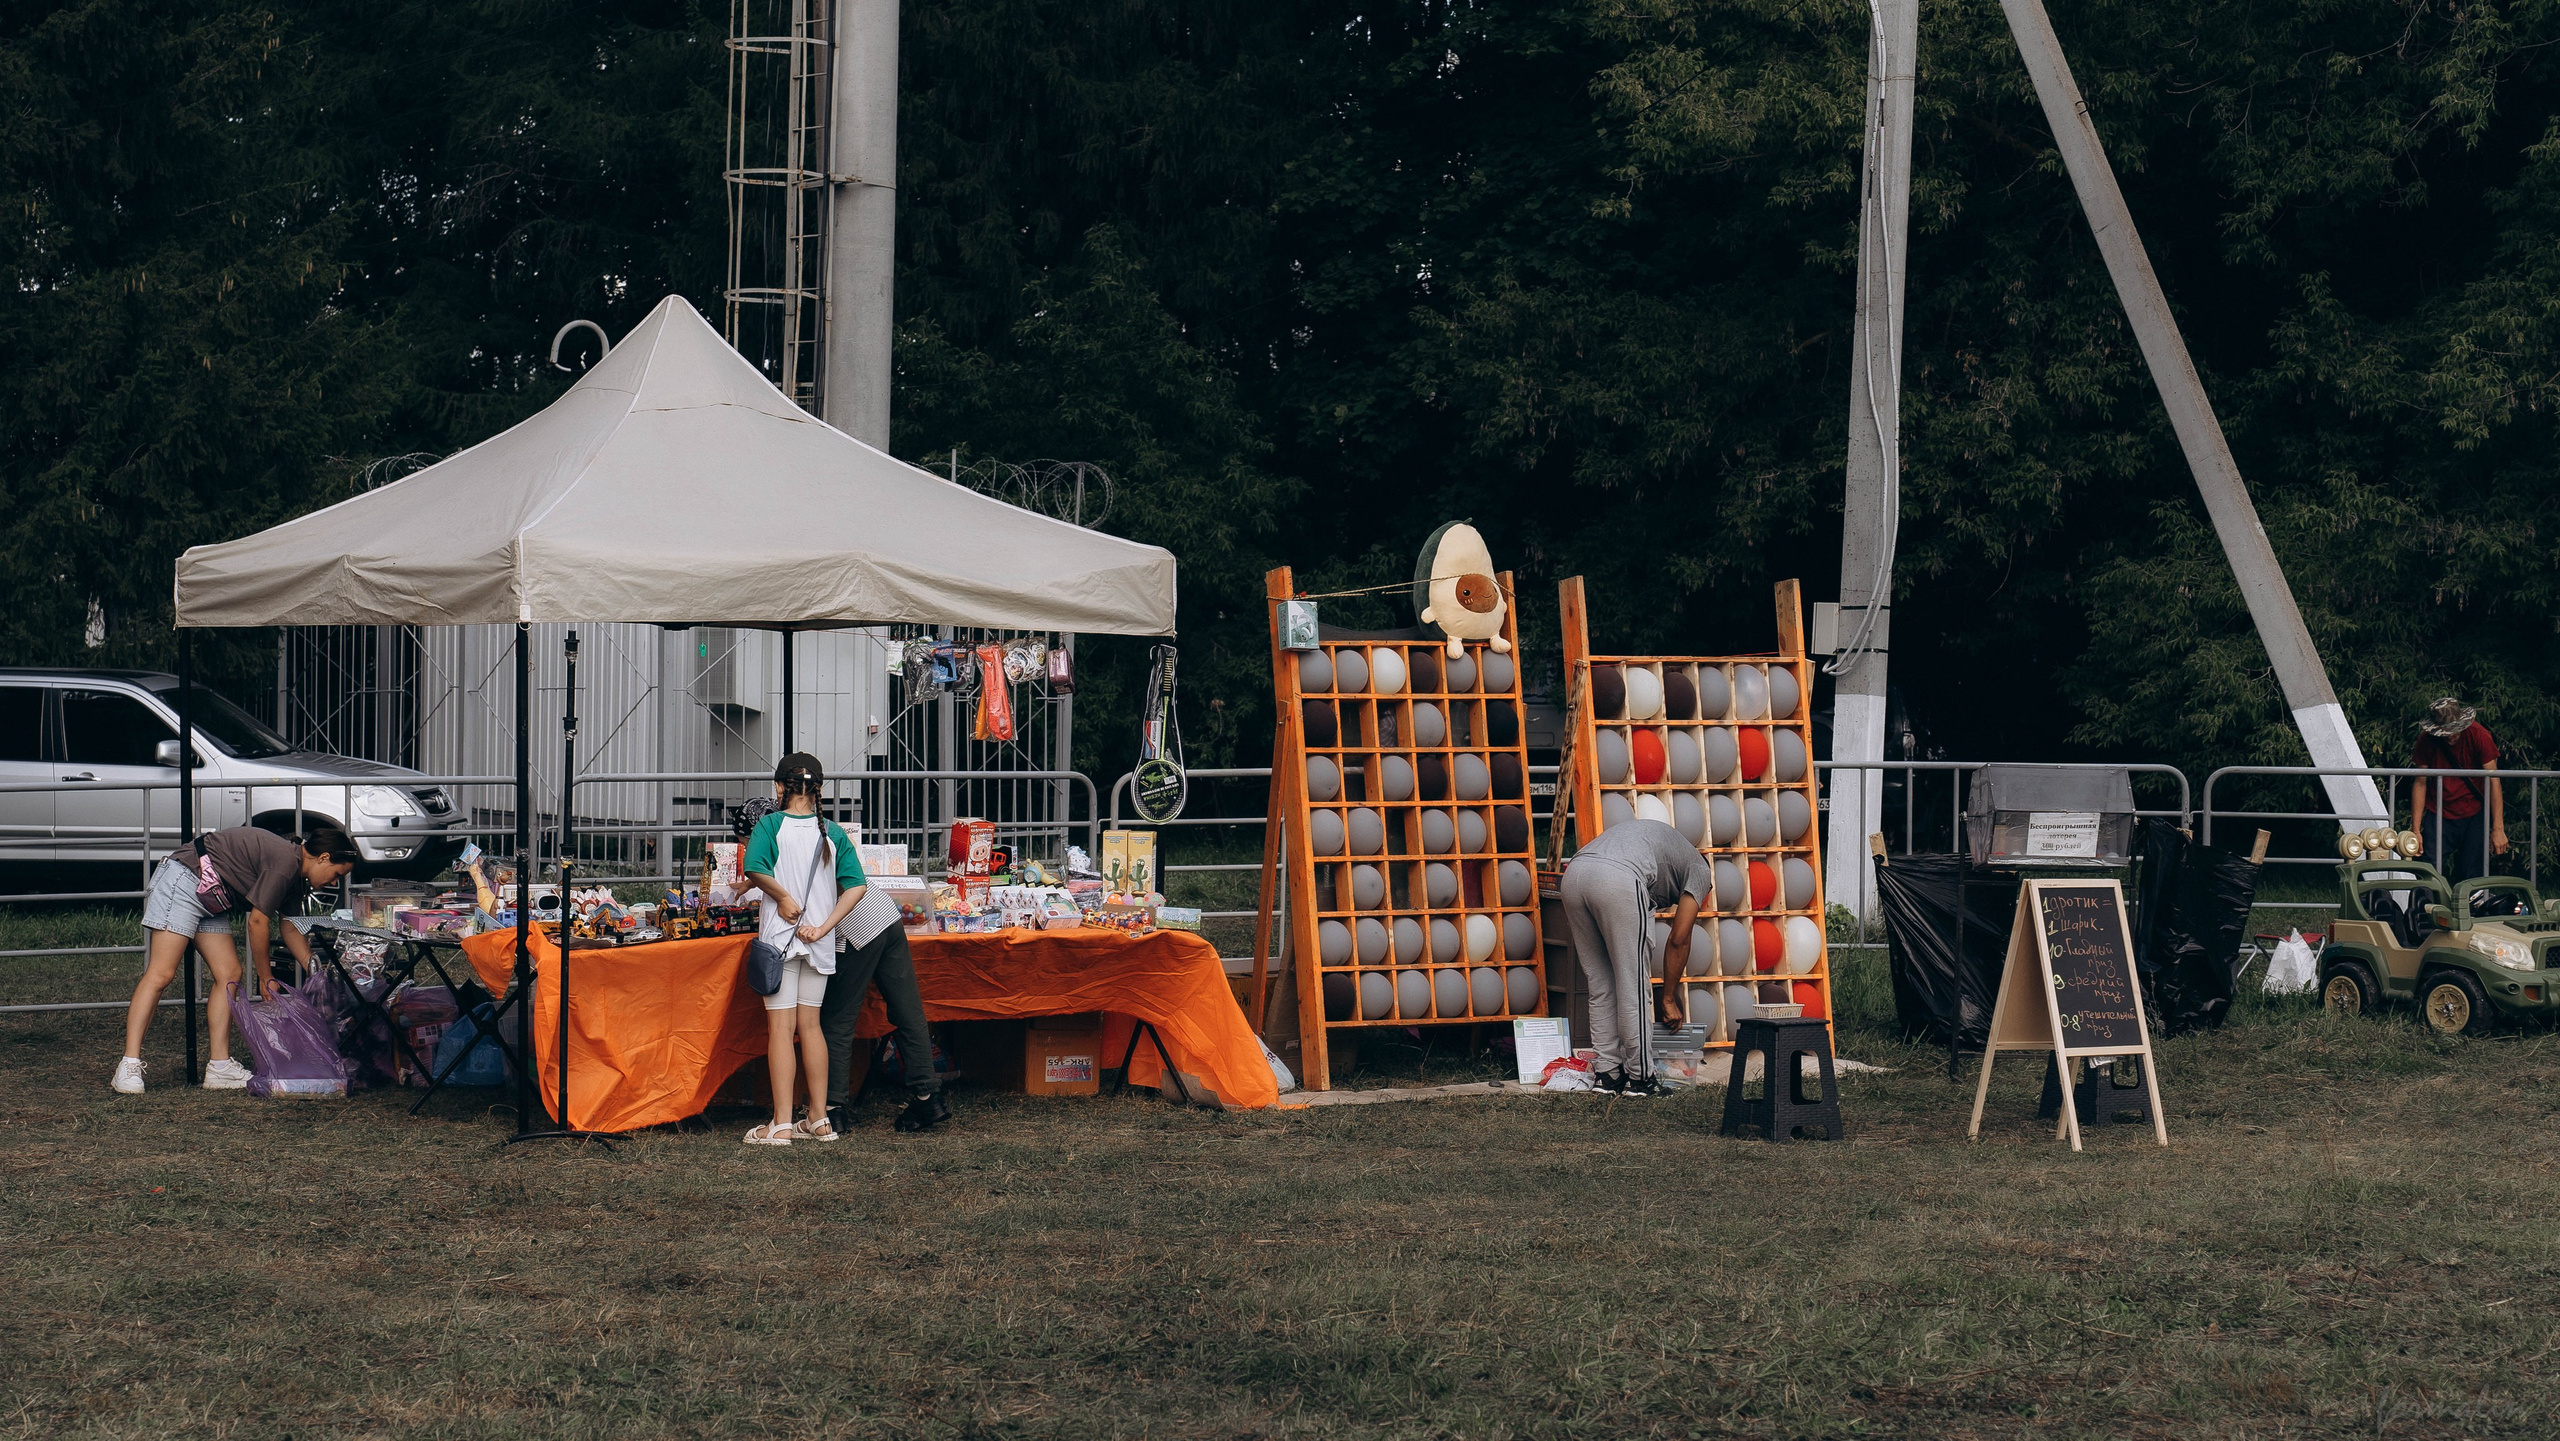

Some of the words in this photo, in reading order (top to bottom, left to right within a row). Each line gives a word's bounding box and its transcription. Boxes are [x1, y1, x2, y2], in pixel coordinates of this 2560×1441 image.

[1540, 784, 1554, 792] 116
[2029, 822, 2097, 831] Беспроигрышная
[2046, 833, 2078, 841] лотерея
[2055, 842, 2082, 851] рублей
